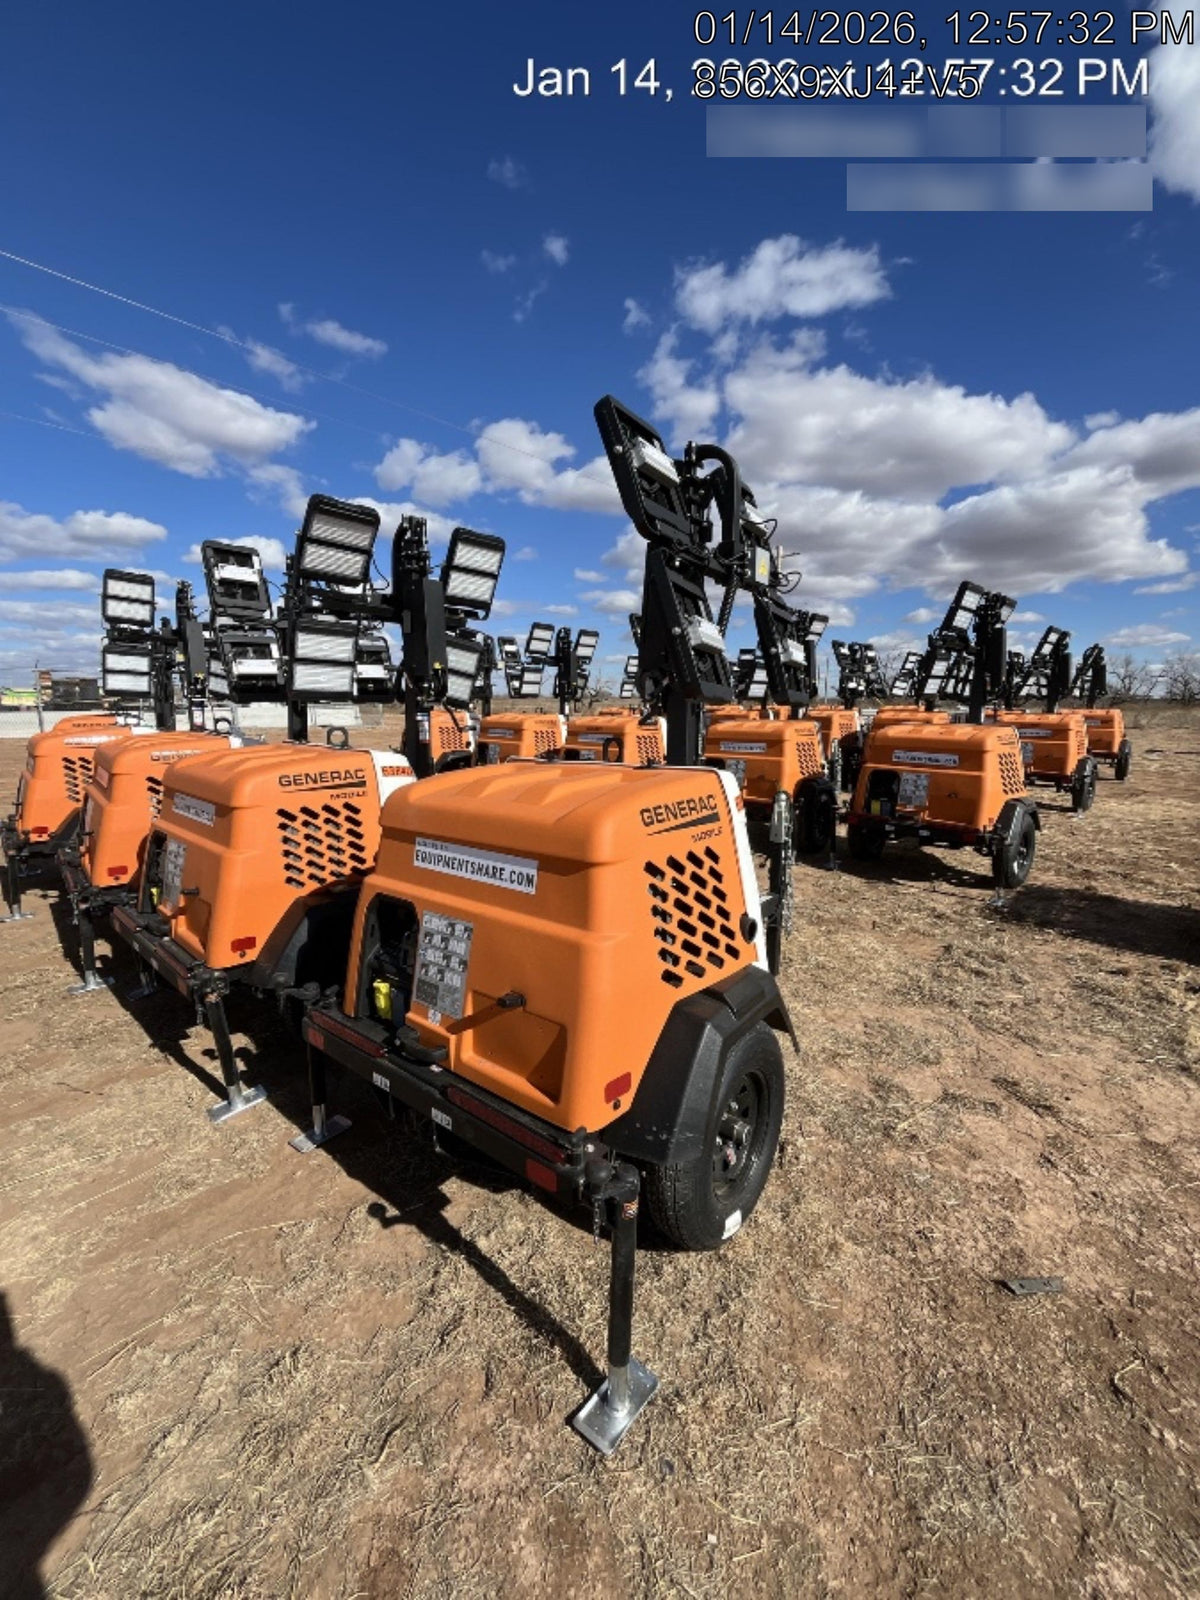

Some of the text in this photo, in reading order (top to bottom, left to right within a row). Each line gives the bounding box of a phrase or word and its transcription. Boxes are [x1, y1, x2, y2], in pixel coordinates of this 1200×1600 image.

[278, 768, 366, 788] GENERAC
[640, 794, 718, 827] GENERAC
[415, 849, 535, 889] EQUIPMENTSHARE.COM
